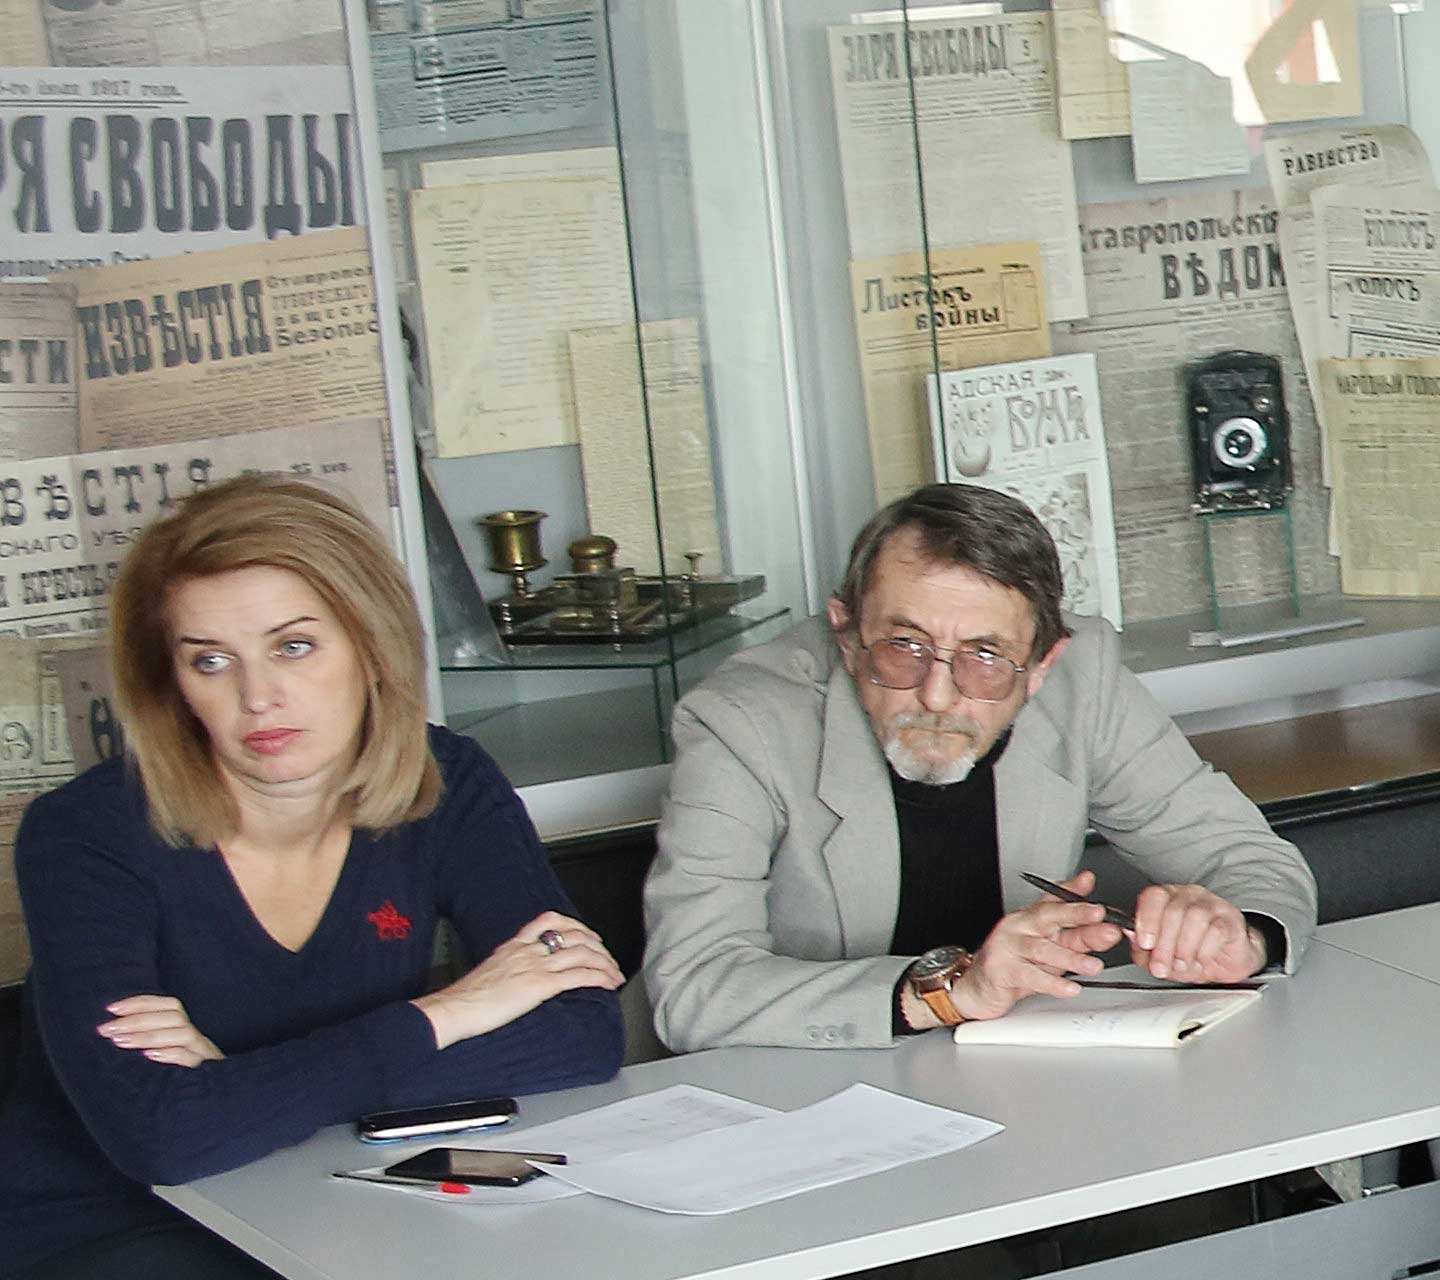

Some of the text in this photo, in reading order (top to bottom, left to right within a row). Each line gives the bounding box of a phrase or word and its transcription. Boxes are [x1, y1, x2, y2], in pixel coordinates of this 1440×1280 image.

[843, 23, 1010, 83] ЗАРЯ СВОБОДЫ
[69, 112, 357, 241] СВОБОДЫ
[860, 276, 973, 318] Листокъ
[75, 277, 273, 380] ИЗВѢСТІЯ
[950, 370, 1036, 399] АДСКАЯ
